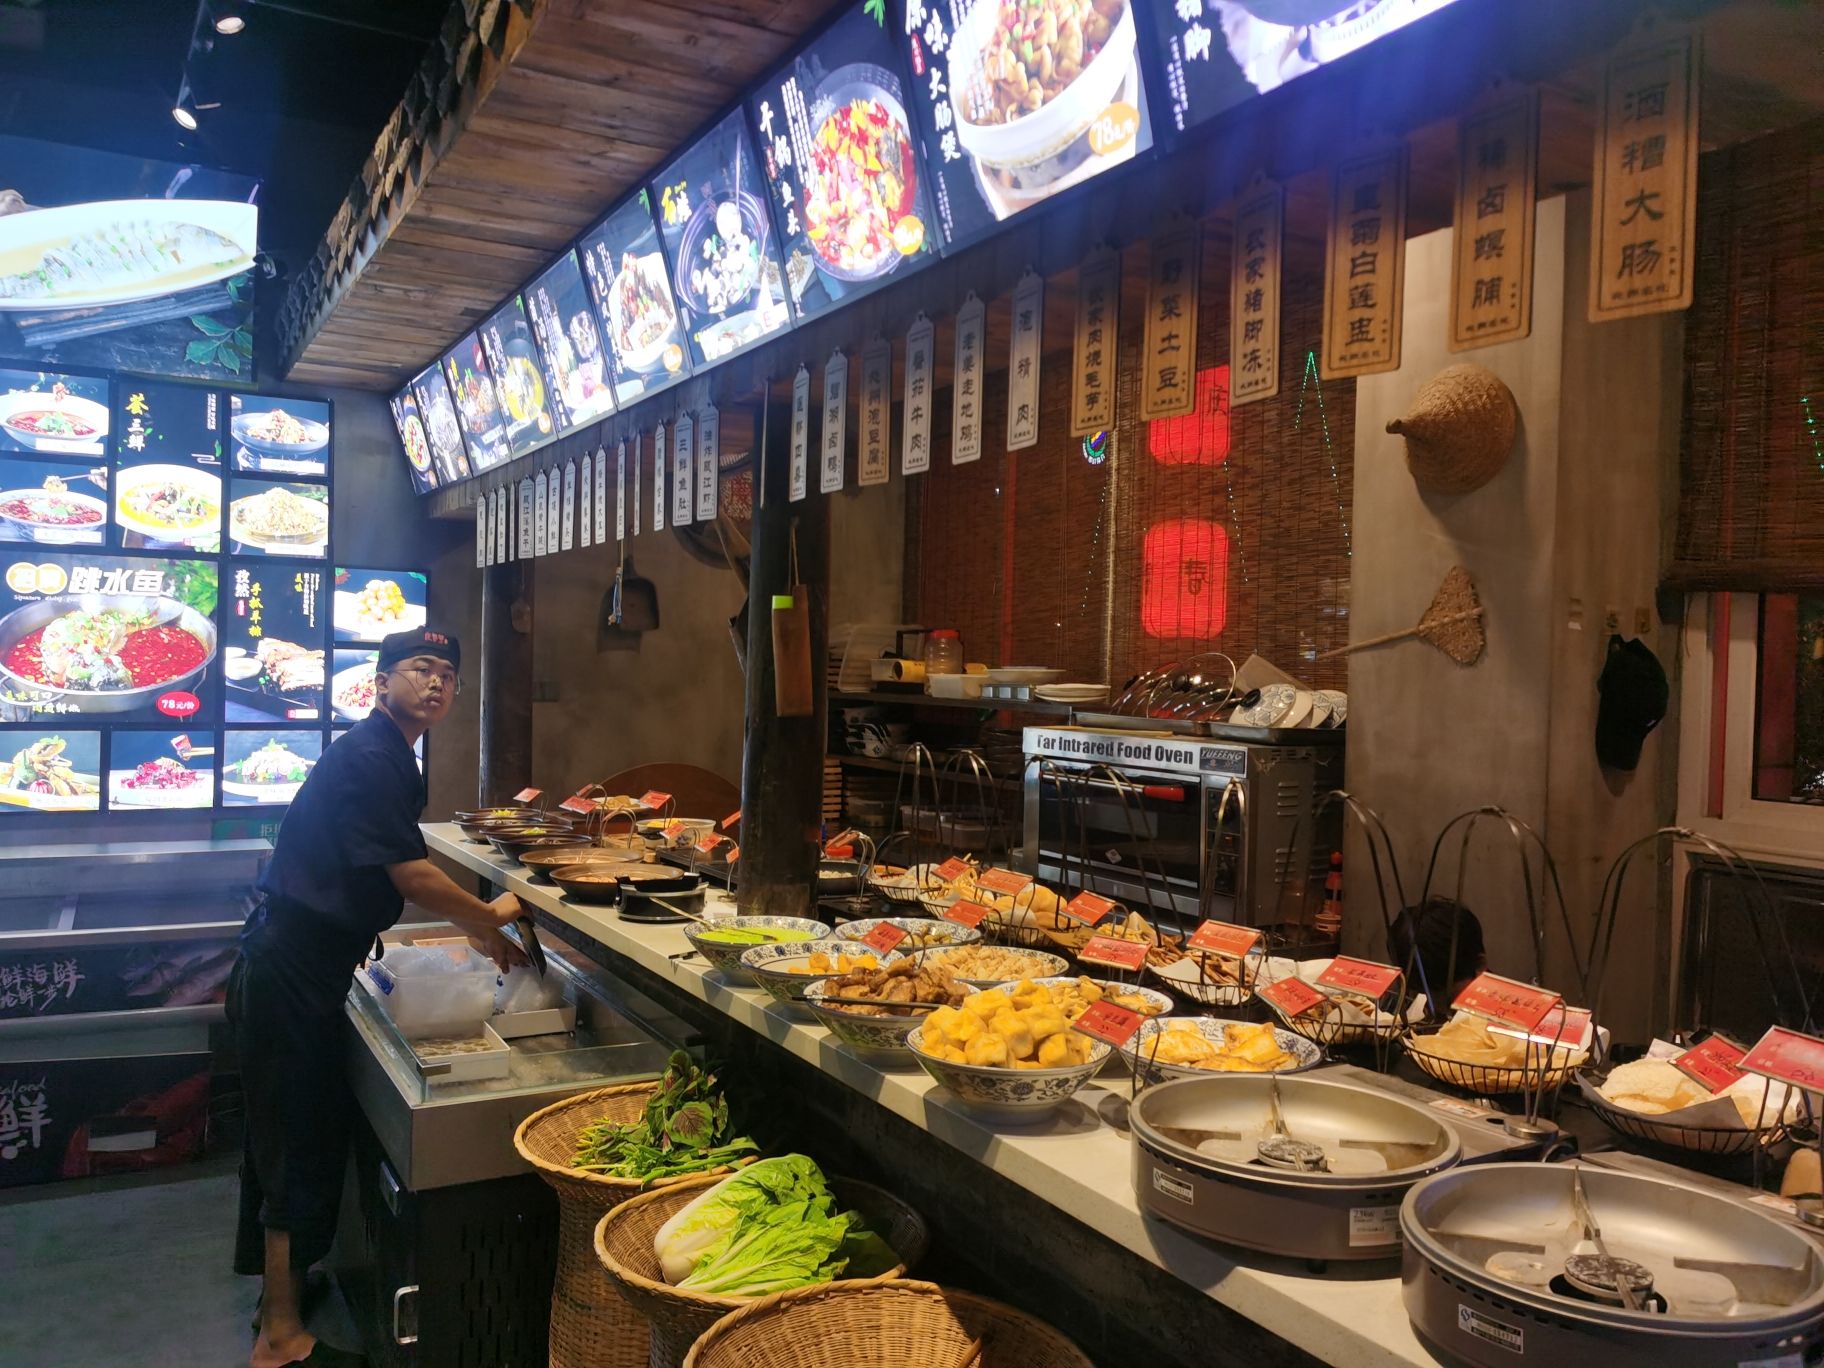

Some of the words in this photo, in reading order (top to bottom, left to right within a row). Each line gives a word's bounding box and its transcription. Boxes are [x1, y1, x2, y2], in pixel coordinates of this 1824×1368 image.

[68, 566, 165, 597] 跳水鱼
[1117, 742, 1151, 761] Food
[1154, 745, 1194, 765] Oven
